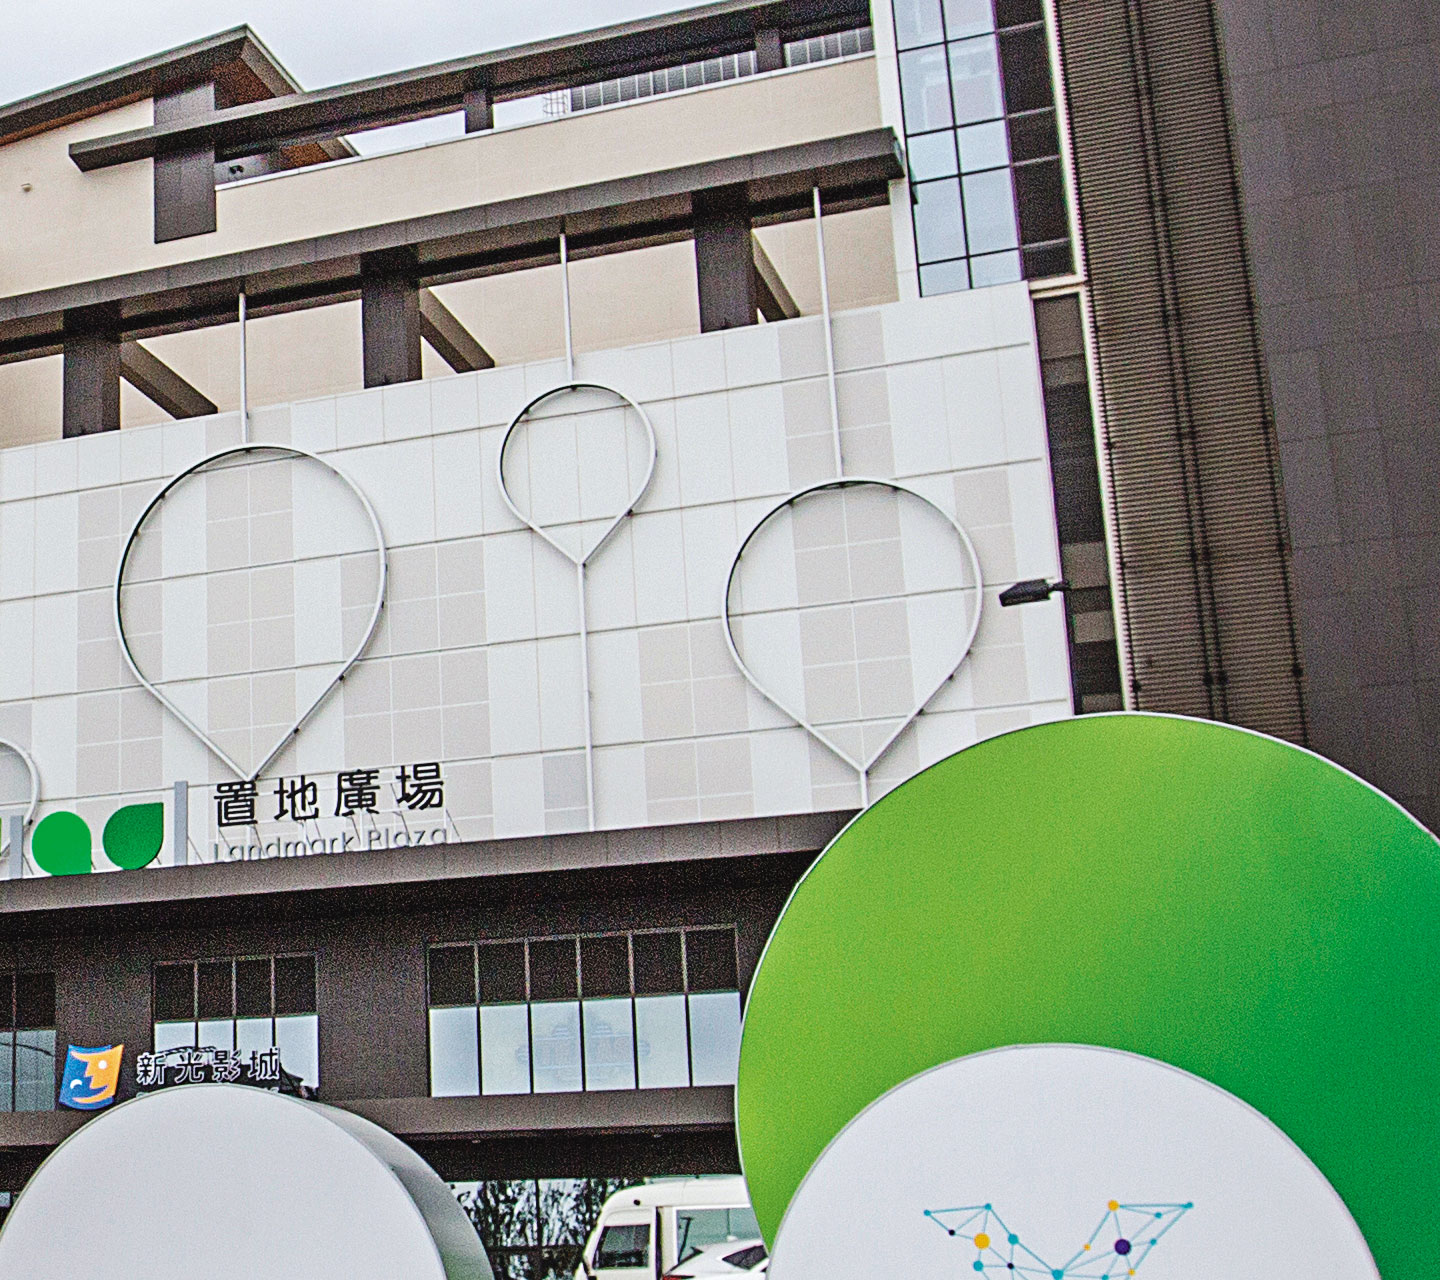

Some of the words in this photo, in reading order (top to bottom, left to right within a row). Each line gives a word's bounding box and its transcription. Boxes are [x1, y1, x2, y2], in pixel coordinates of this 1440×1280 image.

[214, 762, 444, 827] 置地廣場
[367, 826, 449, 850] Plaza
[136, 1047, 281, 1085] 新光影城
